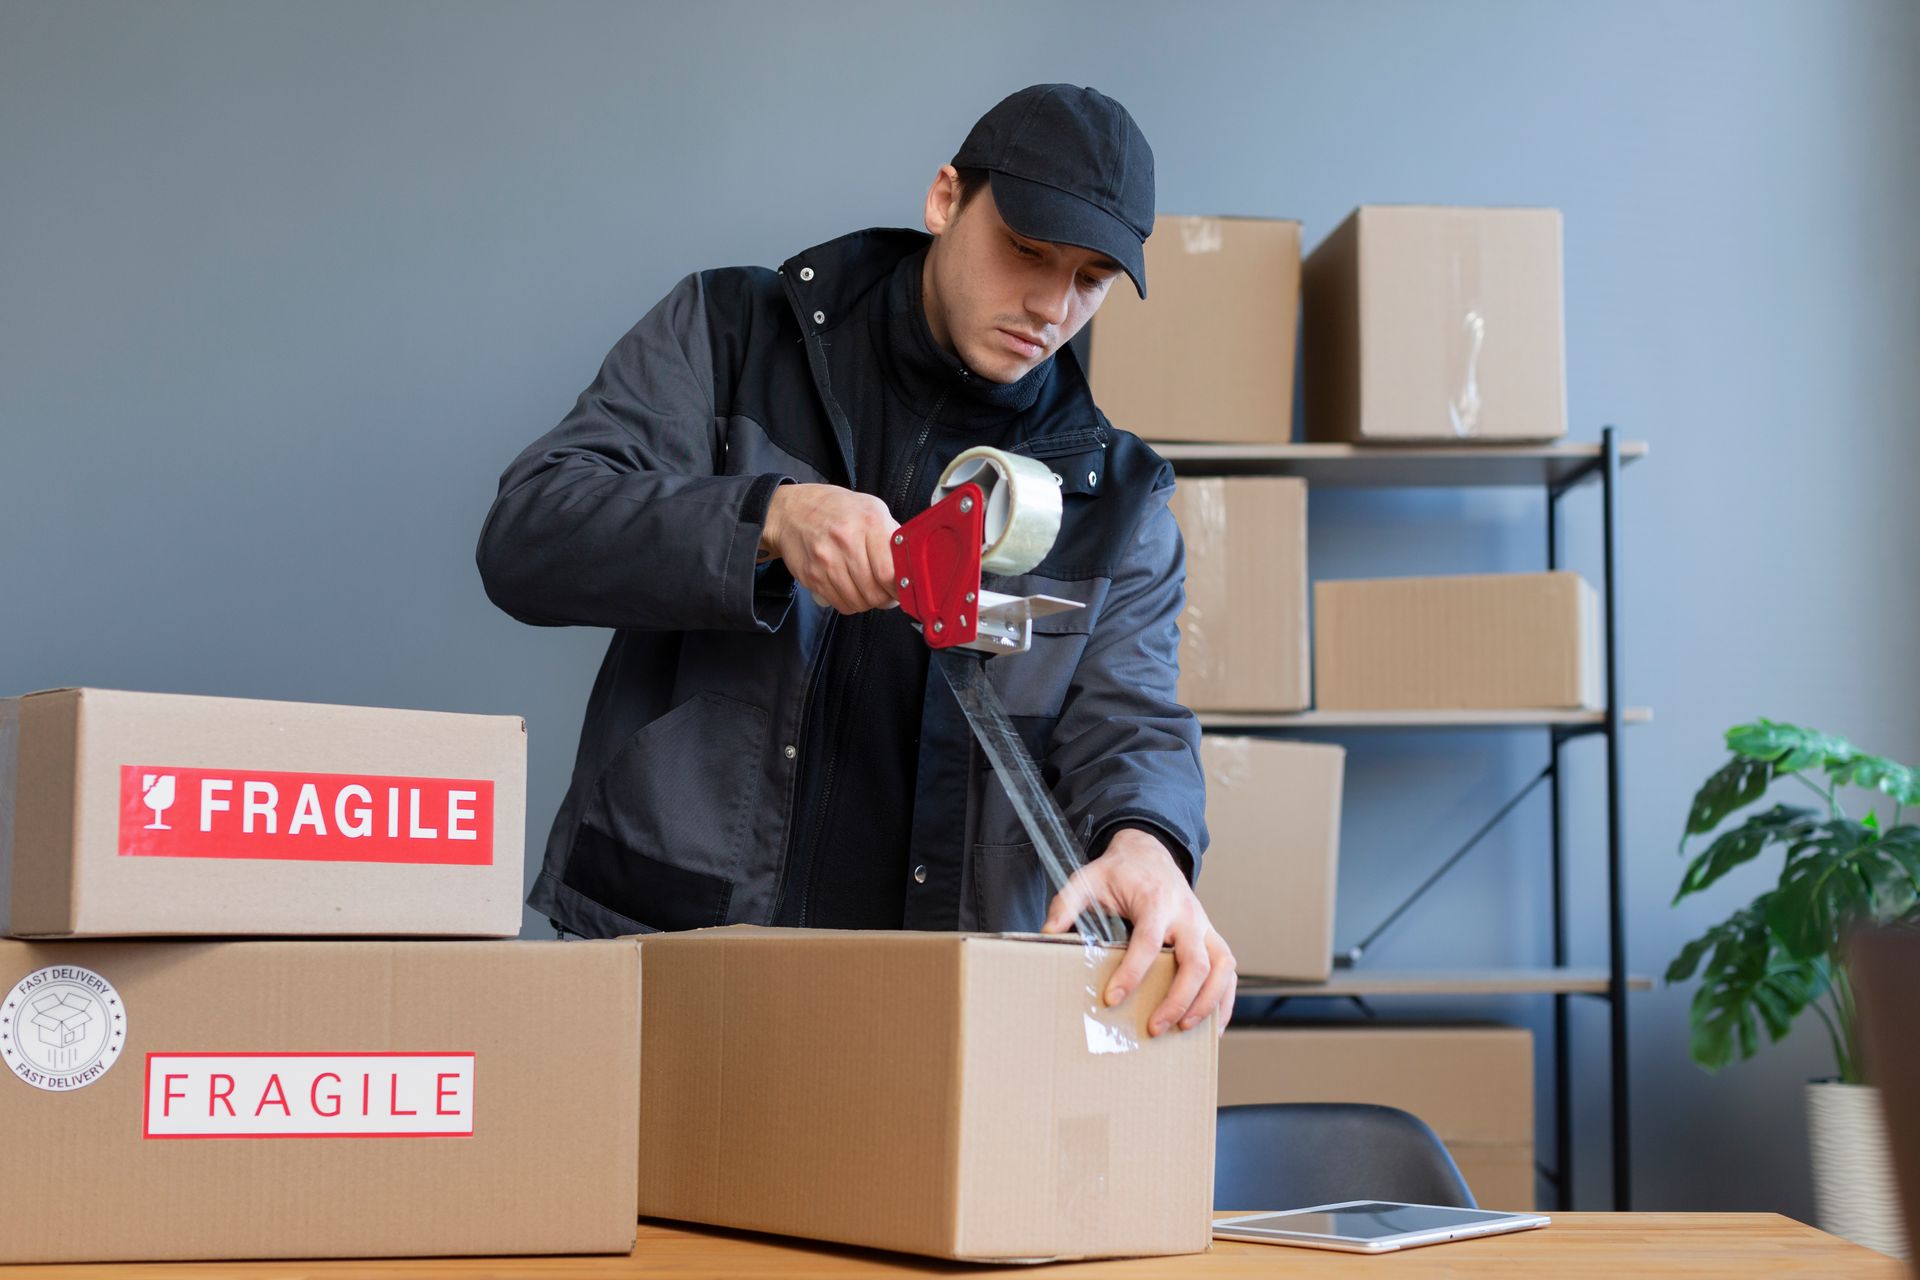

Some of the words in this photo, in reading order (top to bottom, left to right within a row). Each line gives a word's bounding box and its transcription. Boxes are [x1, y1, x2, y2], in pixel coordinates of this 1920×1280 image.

[199, 779, 478, 841] FRAGILE
[19, 972, 48, 995] FAST
[51, 968, 110, 995] DELIVERY
[16, 1062, 46, 1085] FAST
[48, 1060, 105, 1088] DELIVERY
[163, 1073, 462, 1117] FRAGILE
